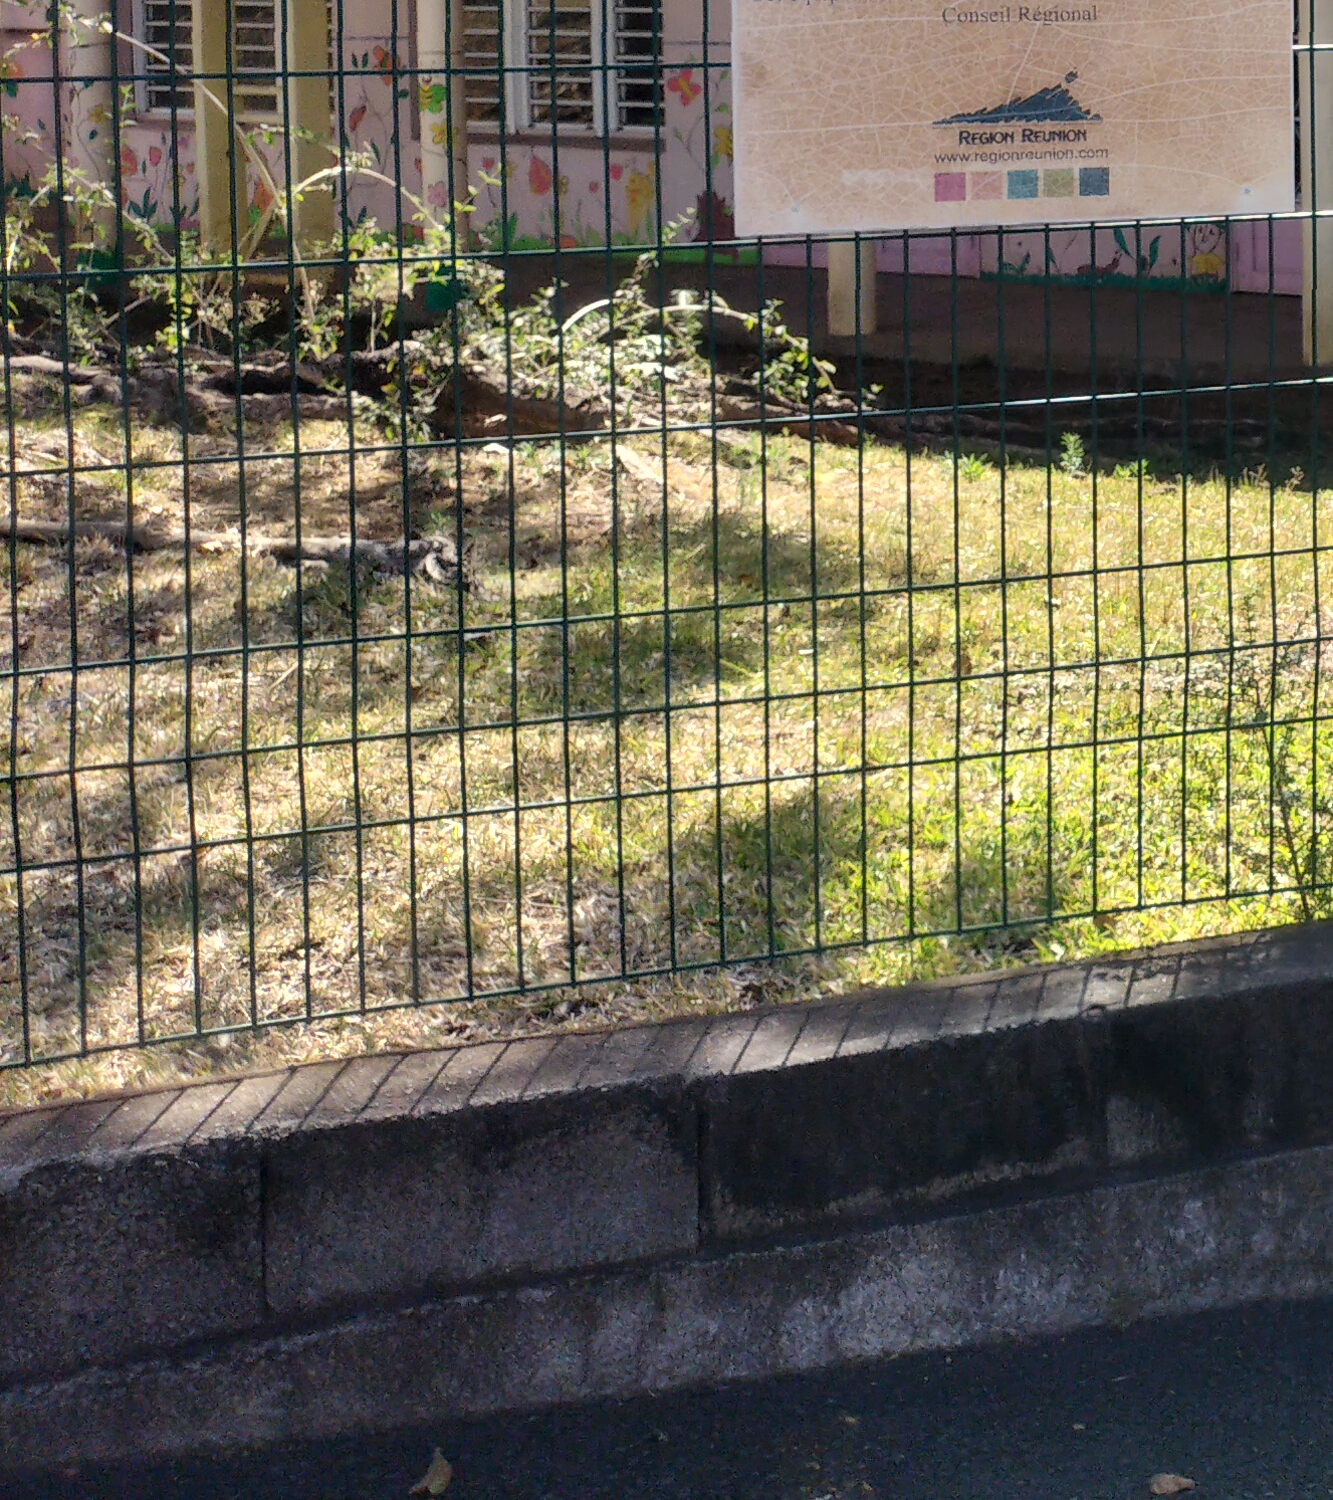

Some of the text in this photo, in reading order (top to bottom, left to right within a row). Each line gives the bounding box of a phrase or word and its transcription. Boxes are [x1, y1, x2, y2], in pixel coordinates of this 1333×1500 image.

[942, 5, 1097, 25] Conseil Régional
[959, 128, 1087, 145] REGION REUNION
[934, 148, 1108, 164] www.regionreunion.com
